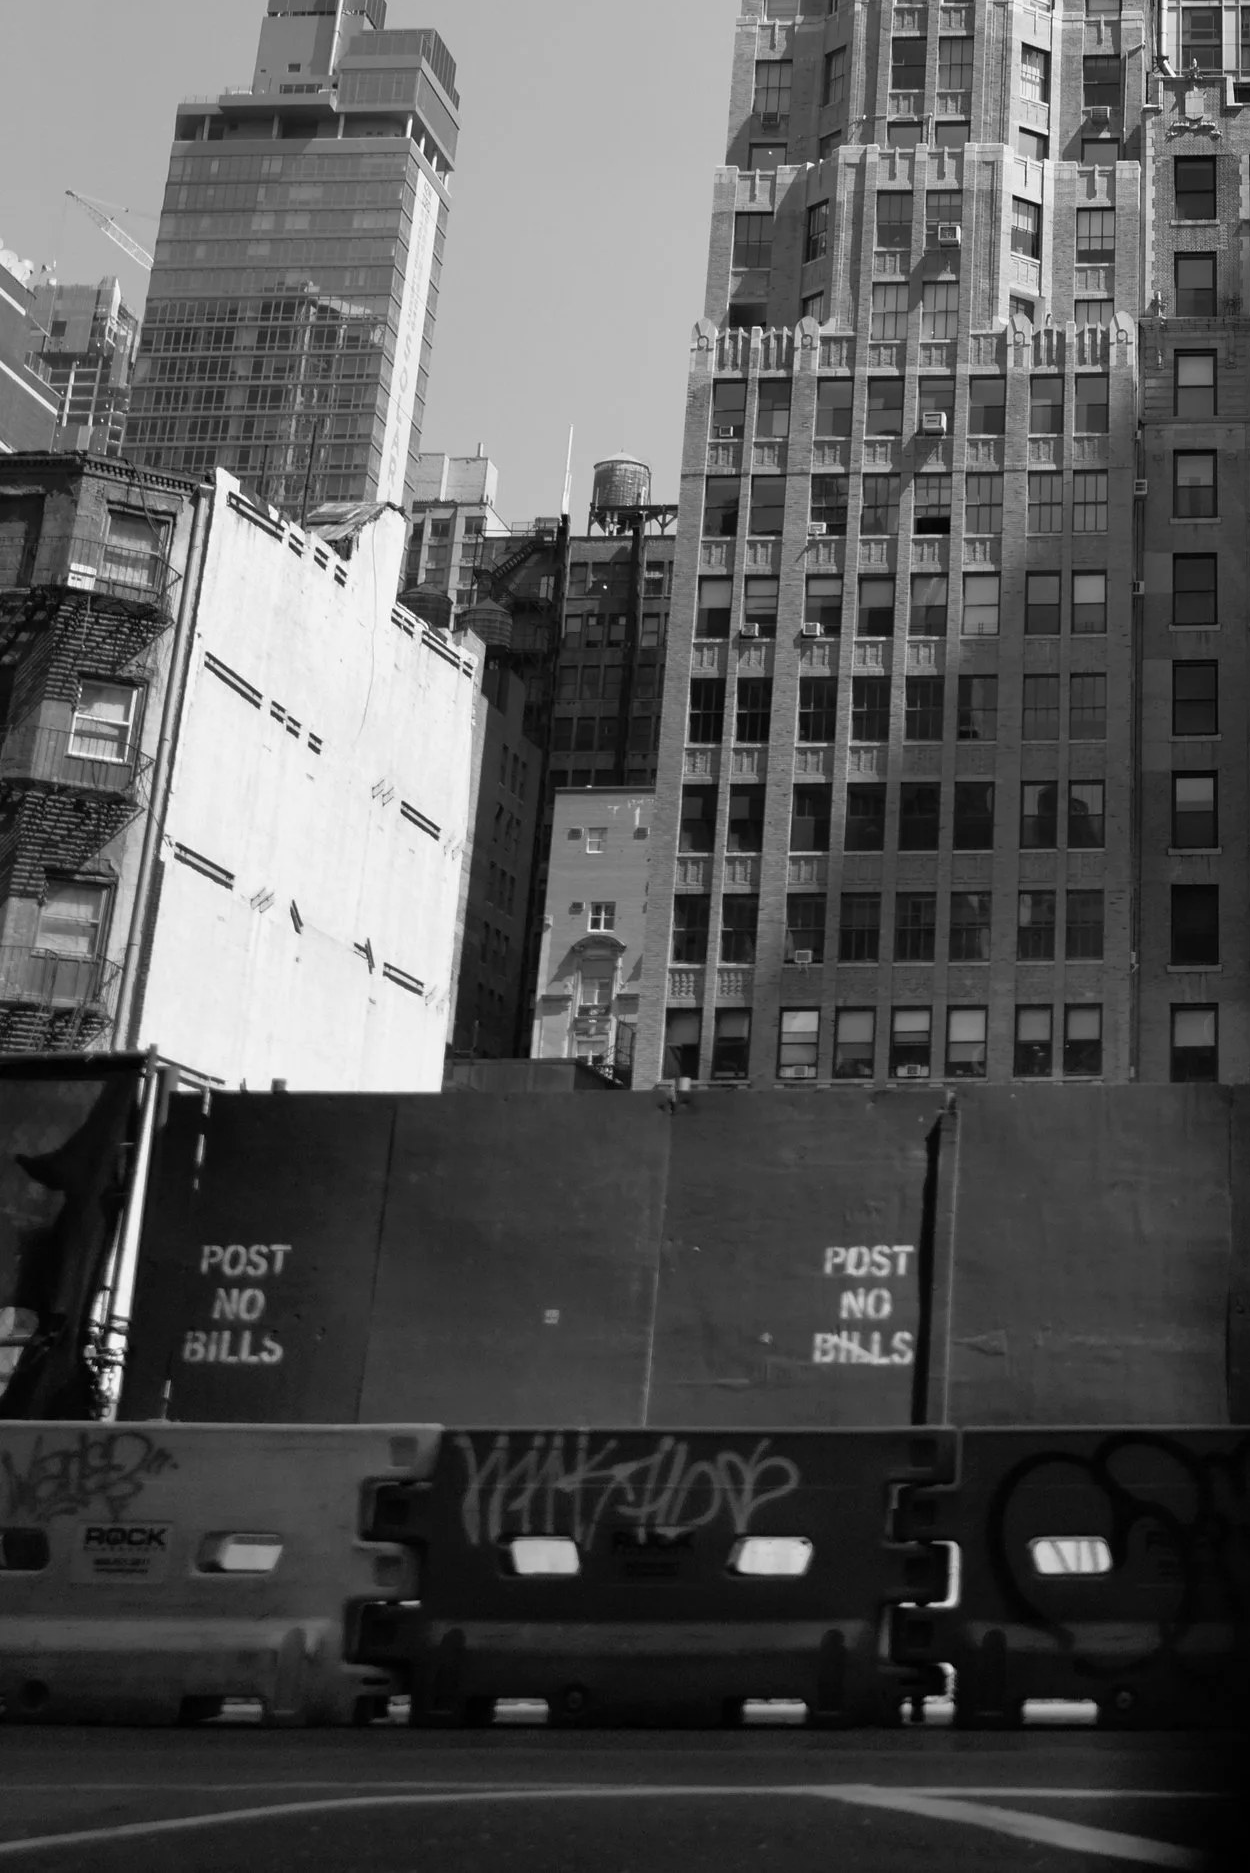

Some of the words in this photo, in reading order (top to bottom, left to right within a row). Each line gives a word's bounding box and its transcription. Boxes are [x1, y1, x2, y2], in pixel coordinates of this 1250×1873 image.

[200, 1244, 293, 1277] POST
[824, 1244, 915, 1277] POST
[212, 1287, 267, 1322] NO
[839, 1287, 893, 1320] NO
[182, 1329, 284, 1365] BILLS
[812, 1330, 915, 1365] BILLS
[86, 1527, 169, 1545] ROCK
